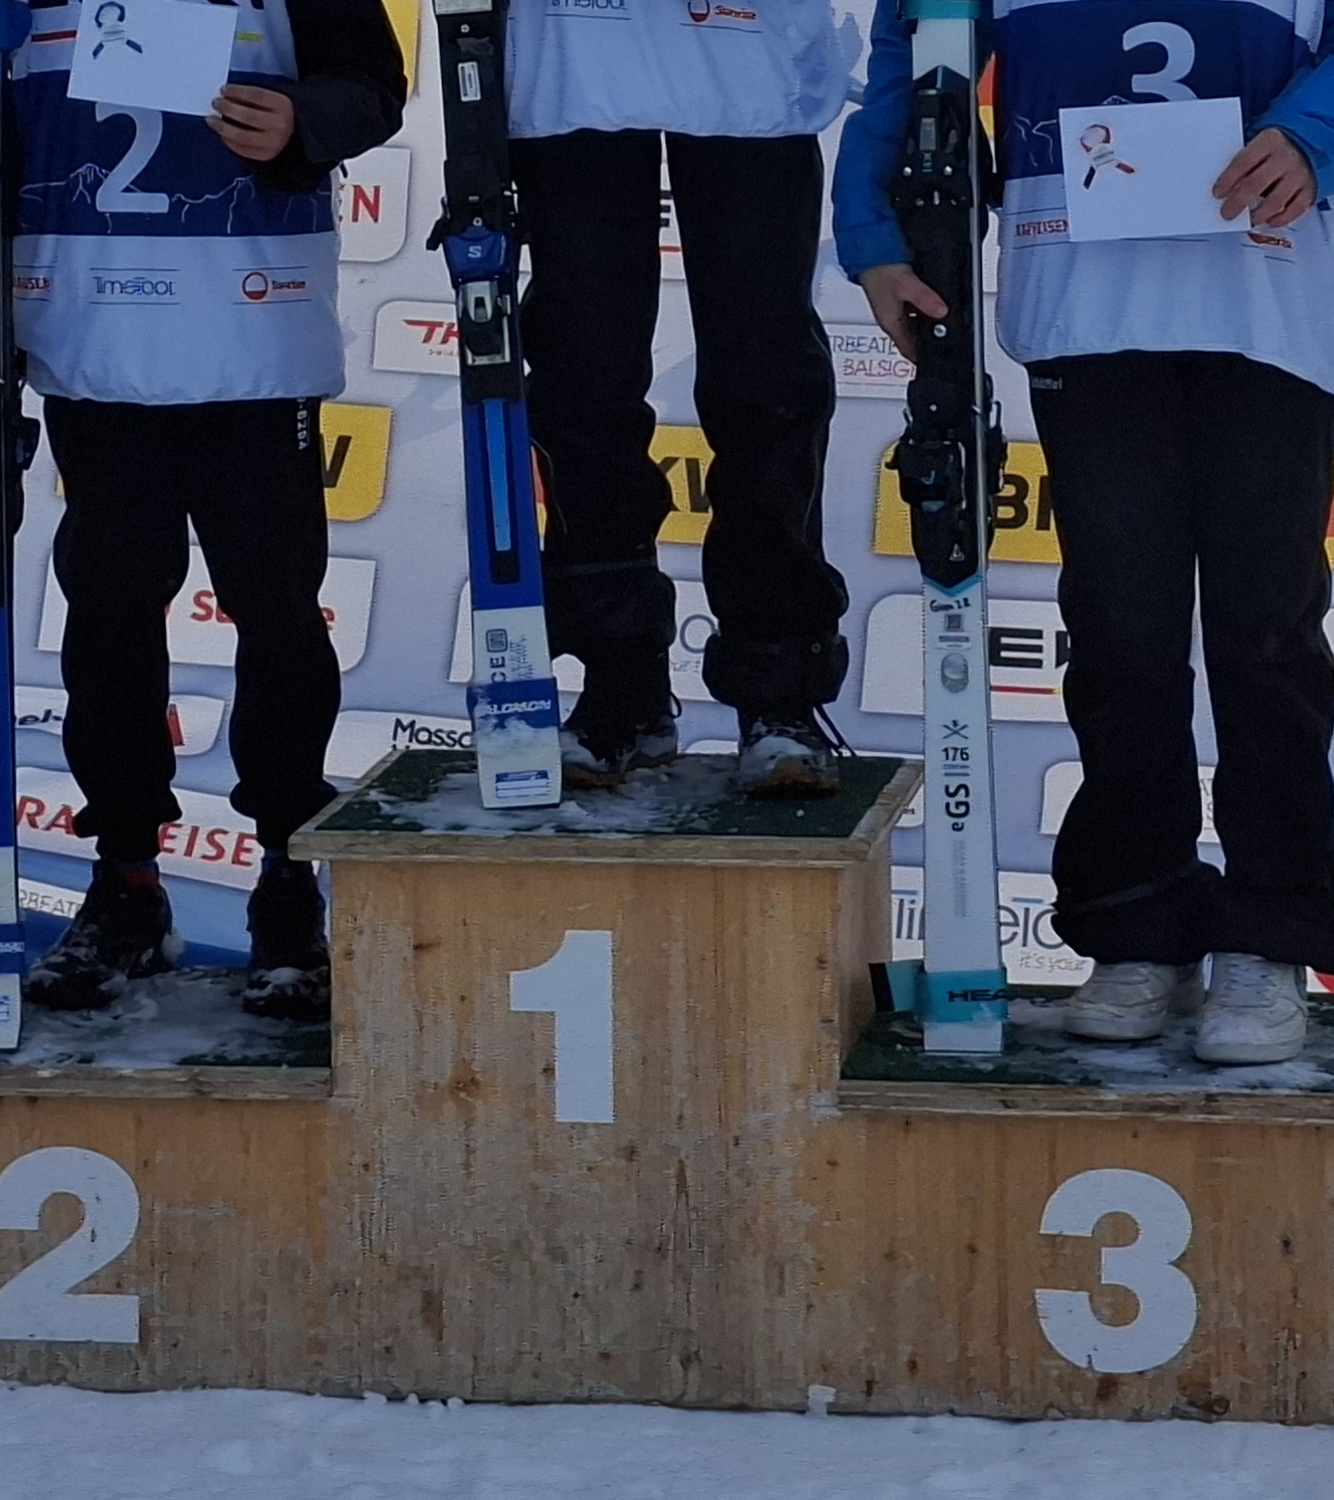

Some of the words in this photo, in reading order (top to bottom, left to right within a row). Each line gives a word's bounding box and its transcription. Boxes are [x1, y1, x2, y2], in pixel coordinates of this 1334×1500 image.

[1121, 22, 1197, 102] 3
[95, 102, 169, 213] 2
[943, 747, 969, 761] 176
[509, 930, 615, 1123] 1
[948, 989, 1008, 1002] HEA
[1034, 1168, 1198, 1373] 3
